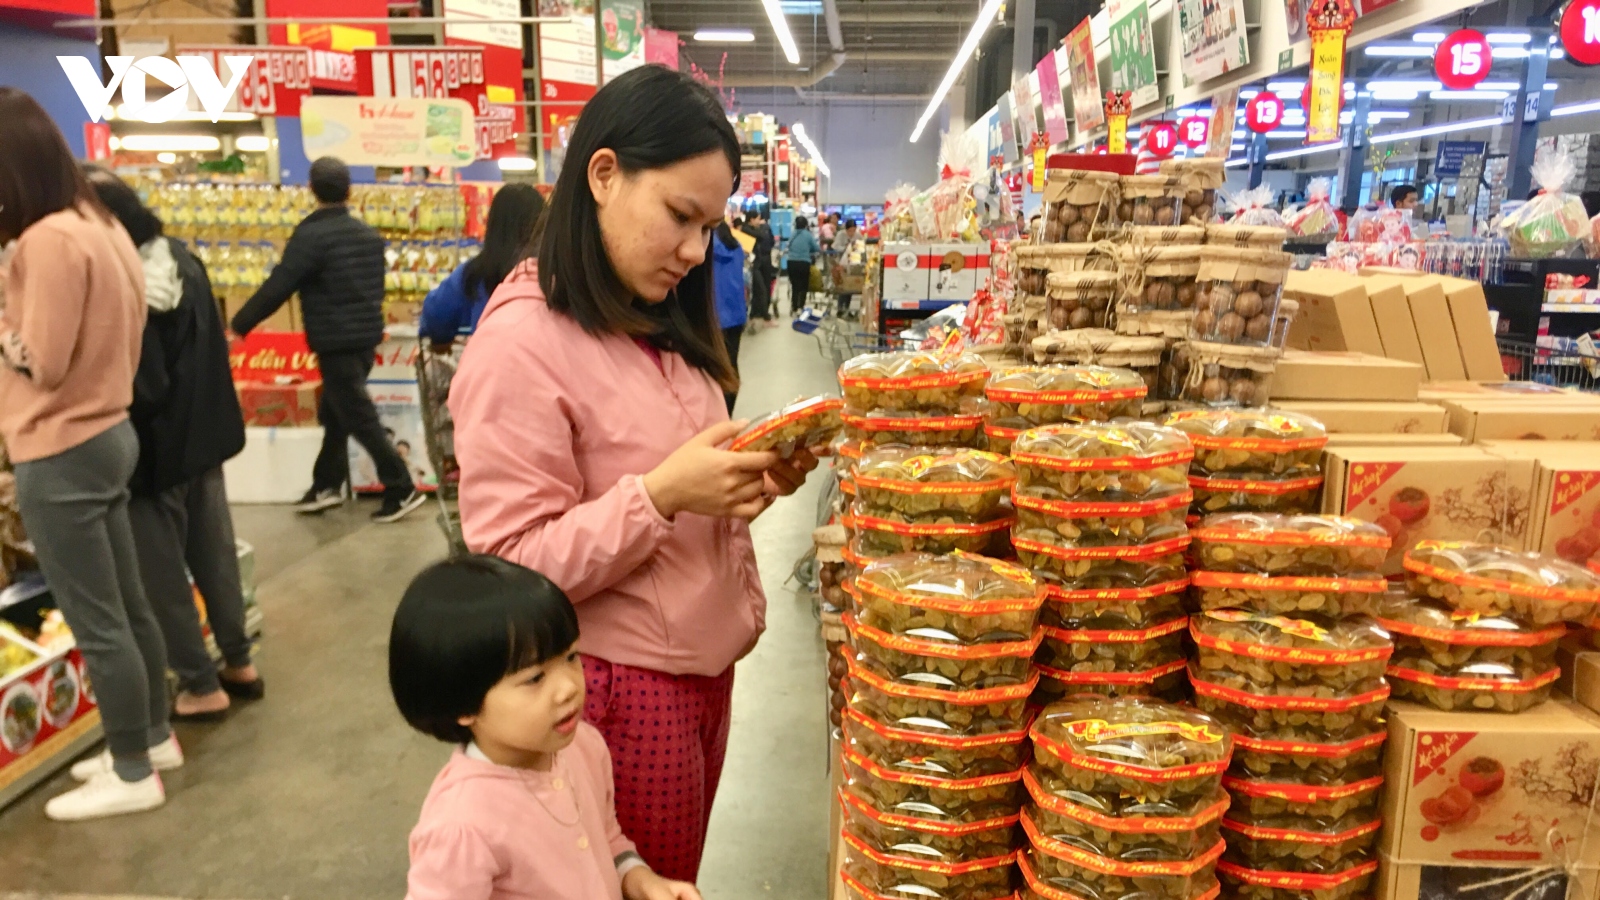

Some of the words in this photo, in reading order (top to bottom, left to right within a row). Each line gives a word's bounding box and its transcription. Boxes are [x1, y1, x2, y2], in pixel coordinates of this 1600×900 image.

[1450, 42, 1482, 76] 15
[1256, 101, 1277, 123] 13
[1504, 101, 1515, 116] 13
[1526, 98, 1539, 113] 14
[1156, 130, 1169, 148] 11
[1187, 121, 1205, 141] 12
